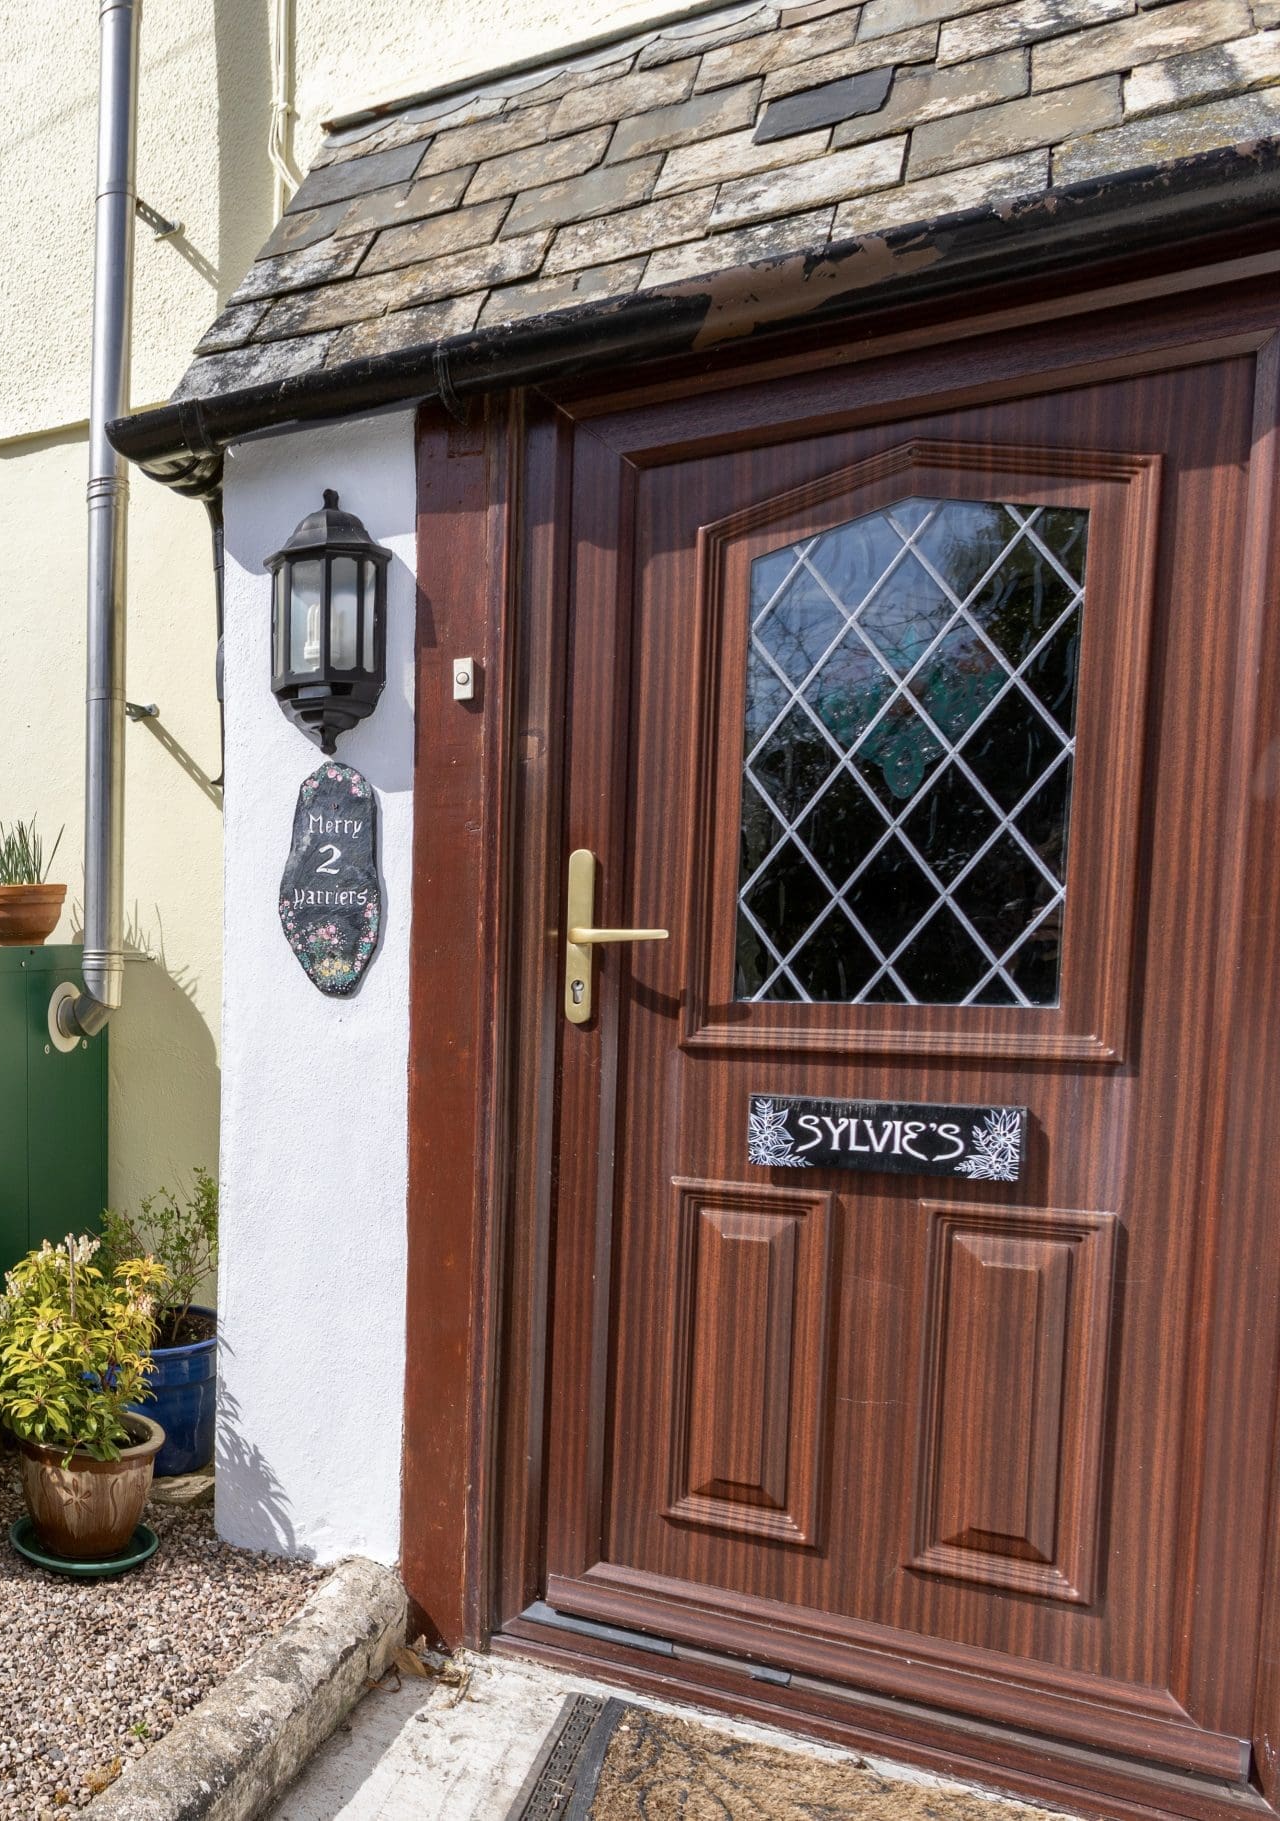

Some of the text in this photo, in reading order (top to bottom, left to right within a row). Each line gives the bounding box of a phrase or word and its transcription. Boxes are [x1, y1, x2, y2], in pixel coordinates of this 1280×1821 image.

[308, 814, 362, 839] Merry
[316, 844, 341, 875] 2
[293, 885, 368, 910] Harriers
[795, 1114, 964, 1161] SYLVIE'S
